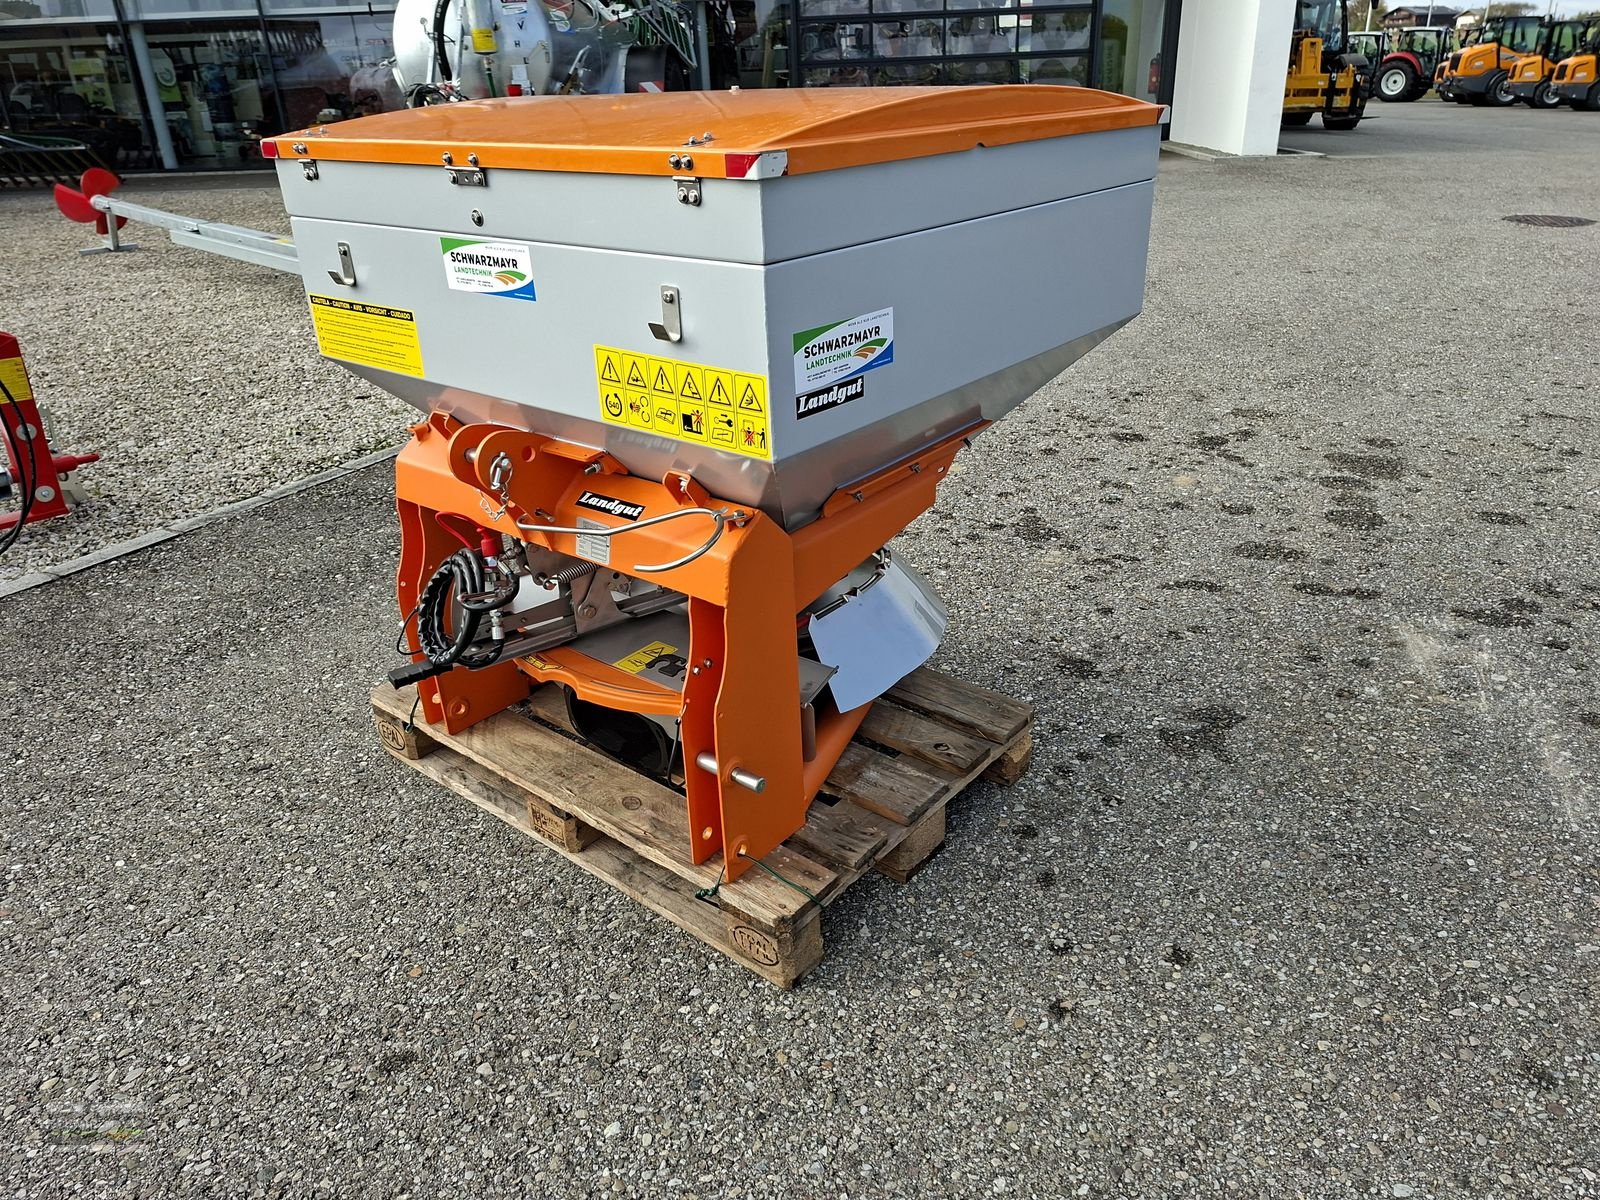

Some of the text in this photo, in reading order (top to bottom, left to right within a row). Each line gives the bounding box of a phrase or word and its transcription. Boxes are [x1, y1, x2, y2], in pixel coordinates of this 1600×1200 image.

[450, 251, 518, 269] SCHWARZMAYR
[454, 266, 493, 277] LANDTECHNIK
[312, 296, 330, 306] CAUTELA
[332, 300, 350, 310] CAUTION
[365, 306, 387, 316] VORSICHT
[390, 310, 411, 319] CUIDADO
[804, 325, 881, 359] SCHWARZMAYR
[806, 350, 852, 371] LANDTECHNIK
[608, 401, 619, 410] 540
[797, 378, 863, 414] Landgut
[579, 492, 643, 517] Landgut
[381, 724, 402, 748] EPAL
